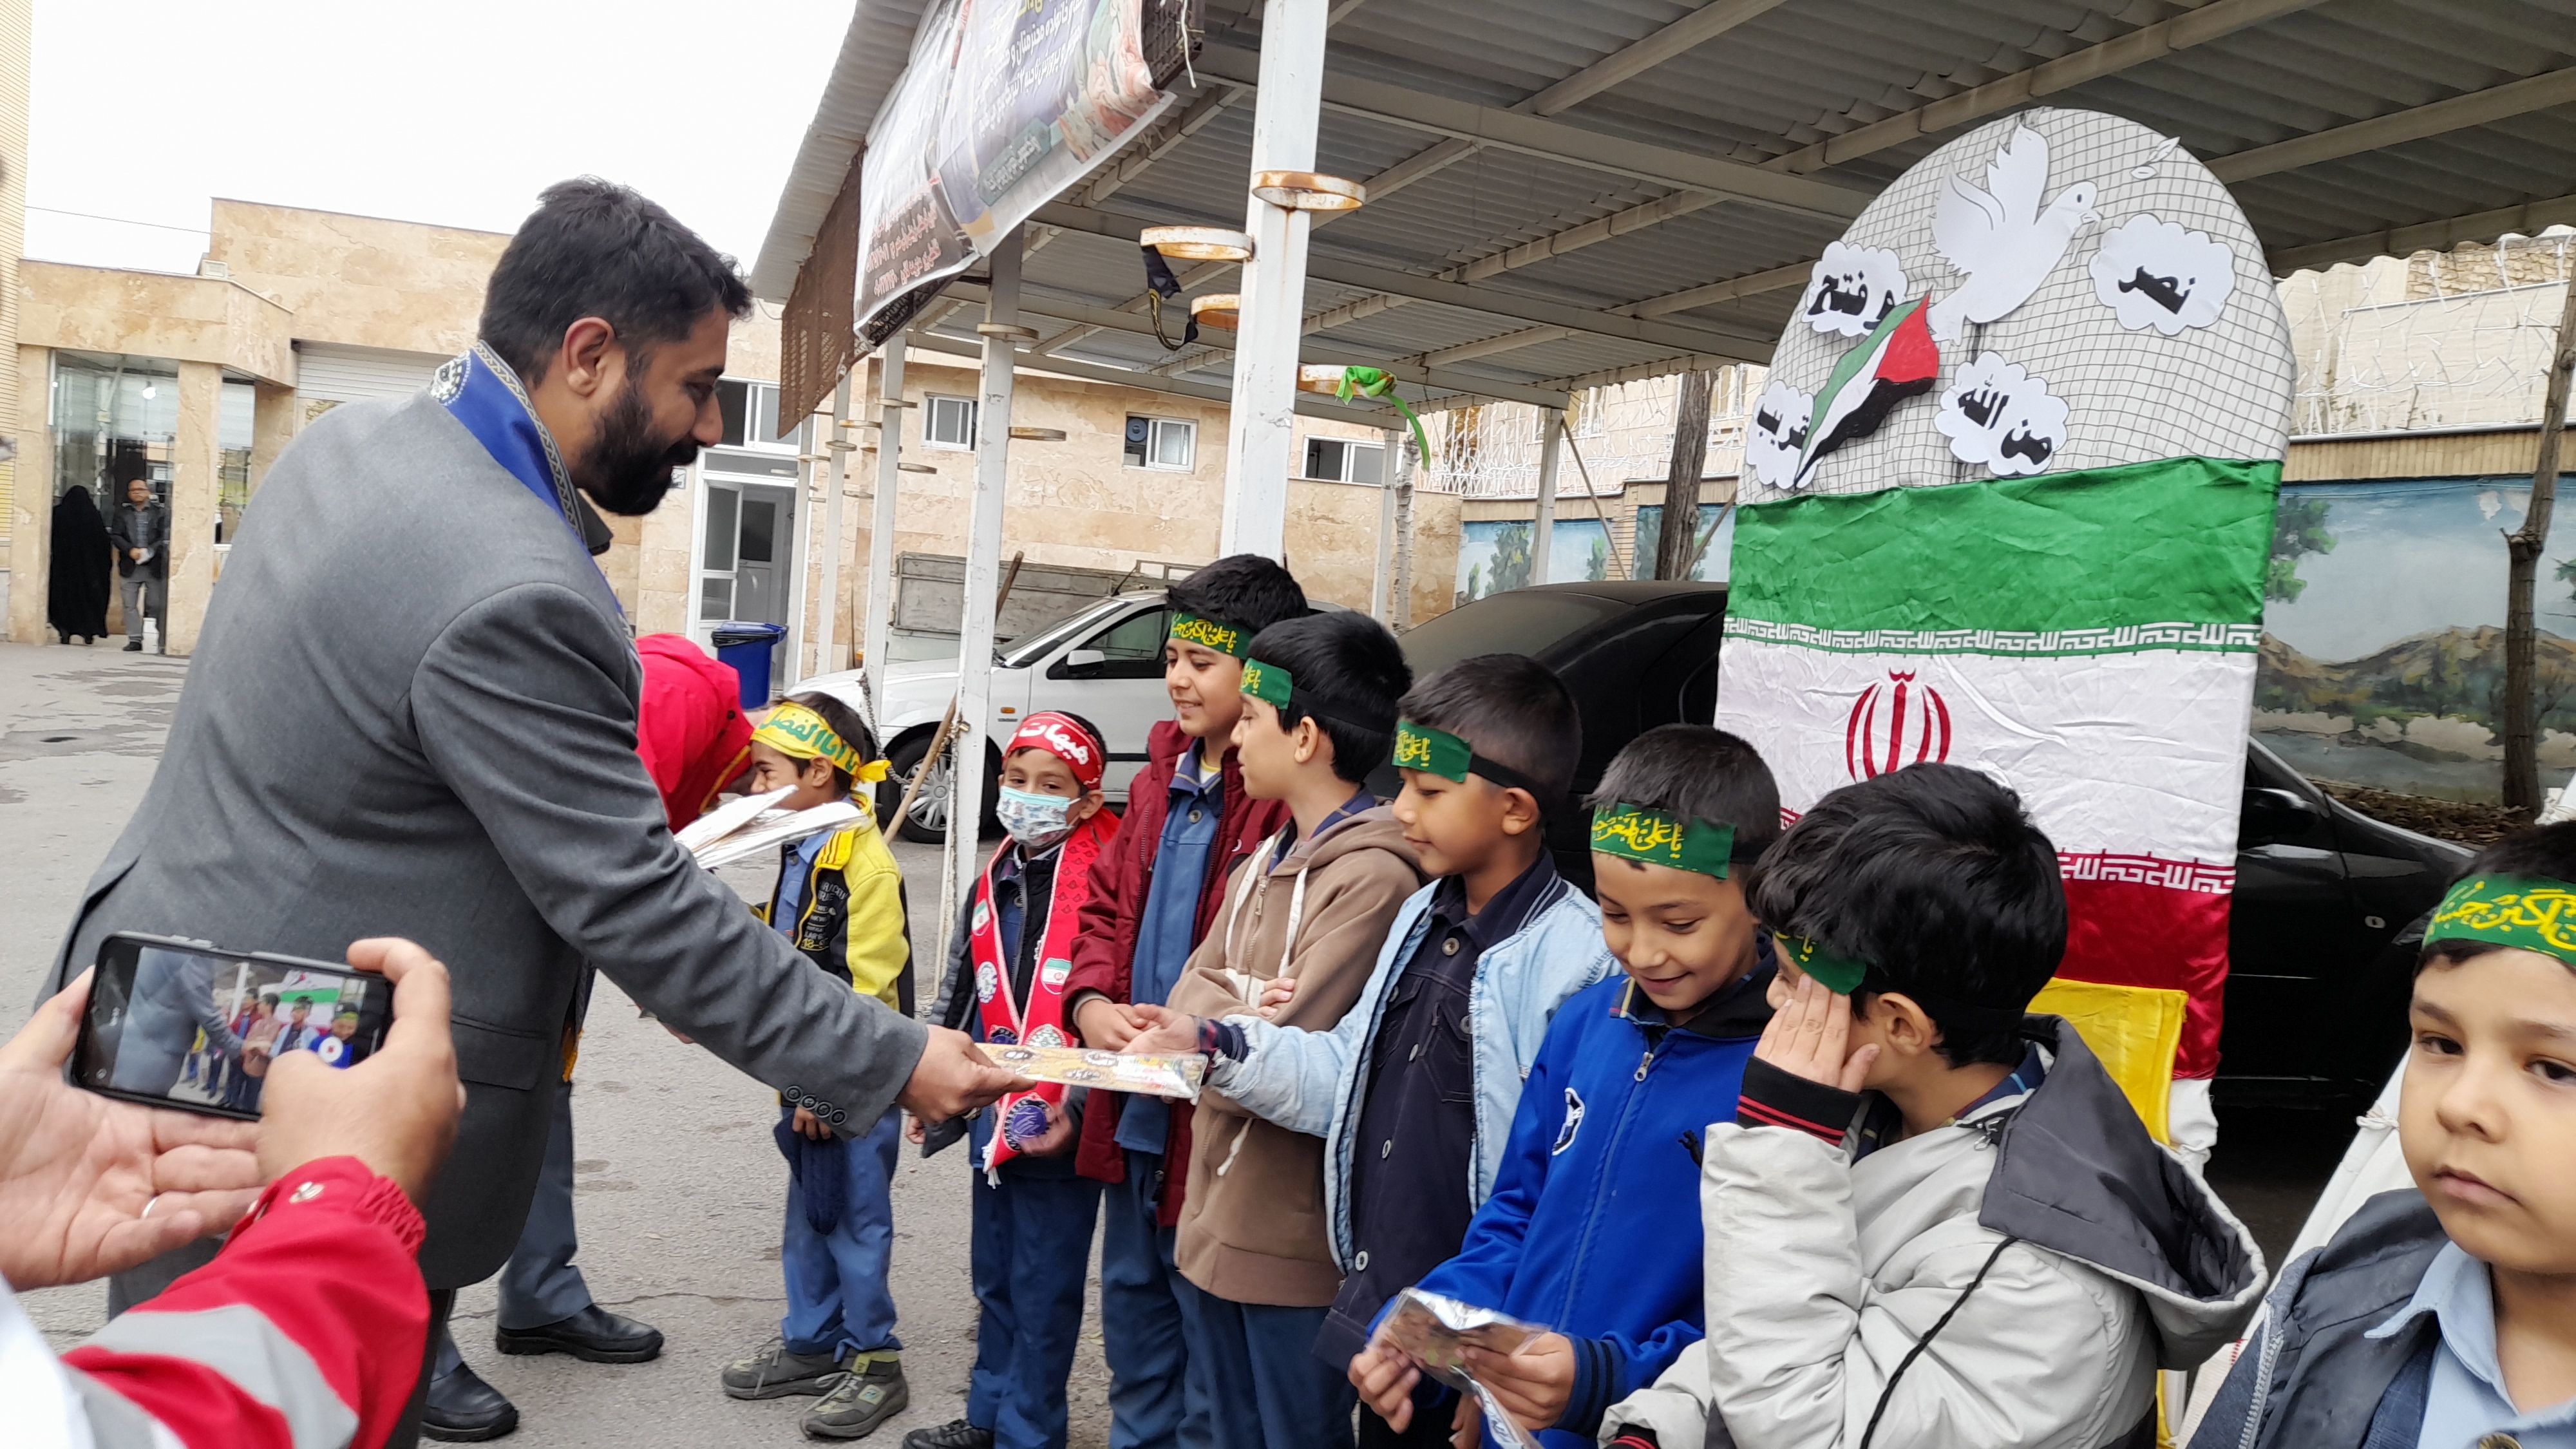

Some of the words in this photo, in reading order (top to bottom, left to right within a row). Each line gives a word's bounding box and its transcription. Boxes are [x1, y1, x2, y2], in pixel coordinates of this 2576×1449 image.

[1808, 270, 1868, 316] فتح
[2118, 265, 2195, 314] نصر
[1958, 375, 2010, 430] الله
[2001, 419, 2052, 465] من
